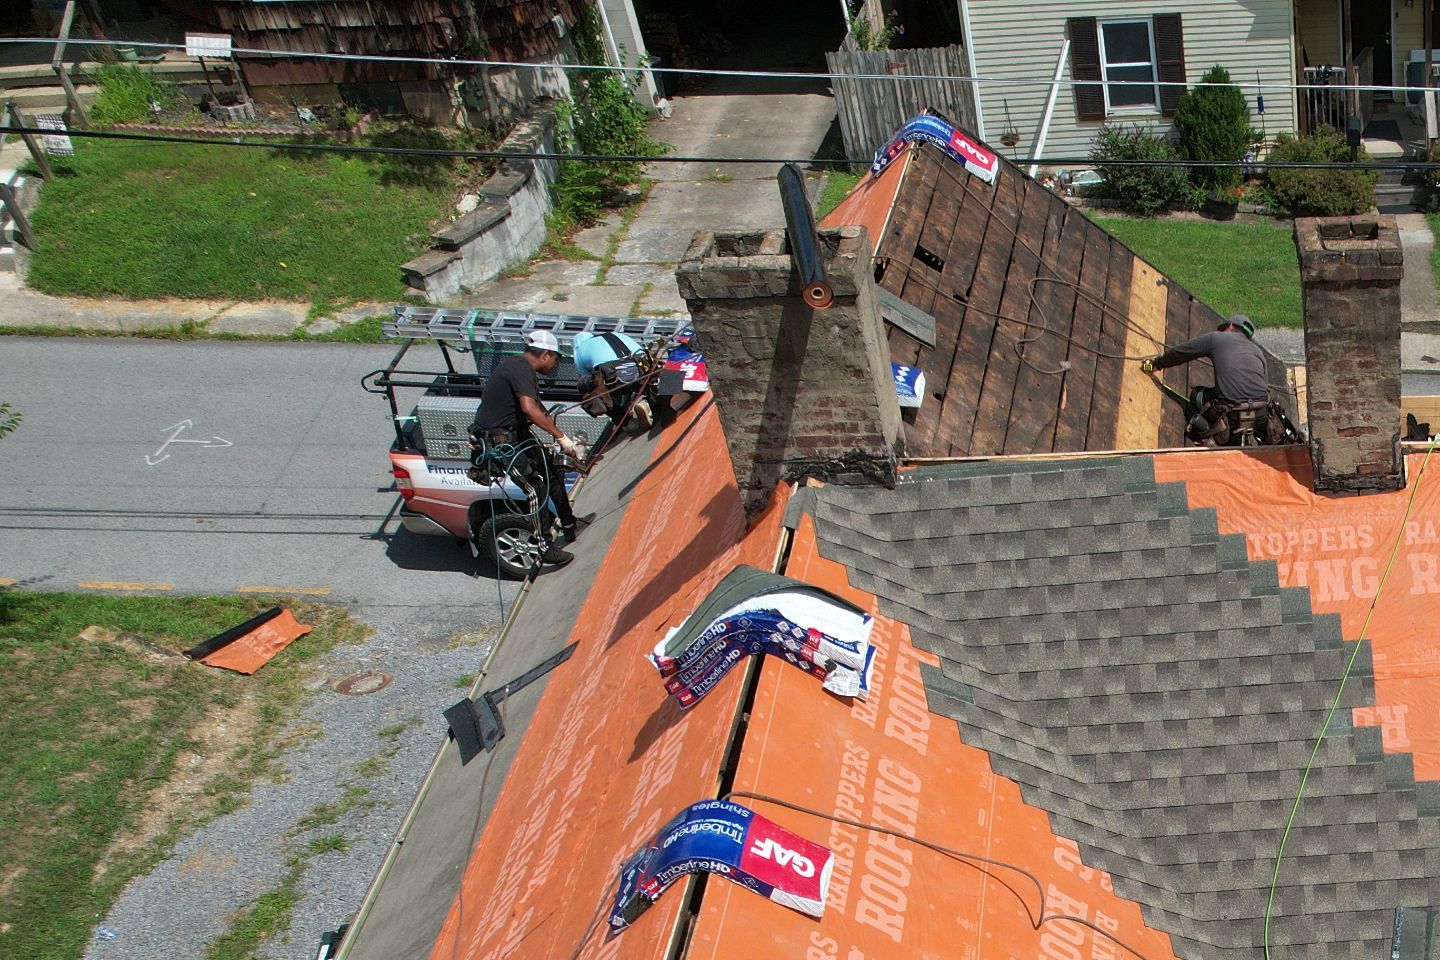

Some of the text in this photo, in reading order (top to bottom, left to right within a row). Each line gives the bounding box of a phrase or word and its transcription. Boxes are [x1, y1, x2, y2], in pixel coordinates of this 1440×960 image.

[955, 138, 989, 165] GAF
[884, 624, 941, 757] ROOFI
[692, 801, 750, 818] Shingles
[751, 837, 815, 878] GAF
[855, 757, 922, 944] ROOFING
